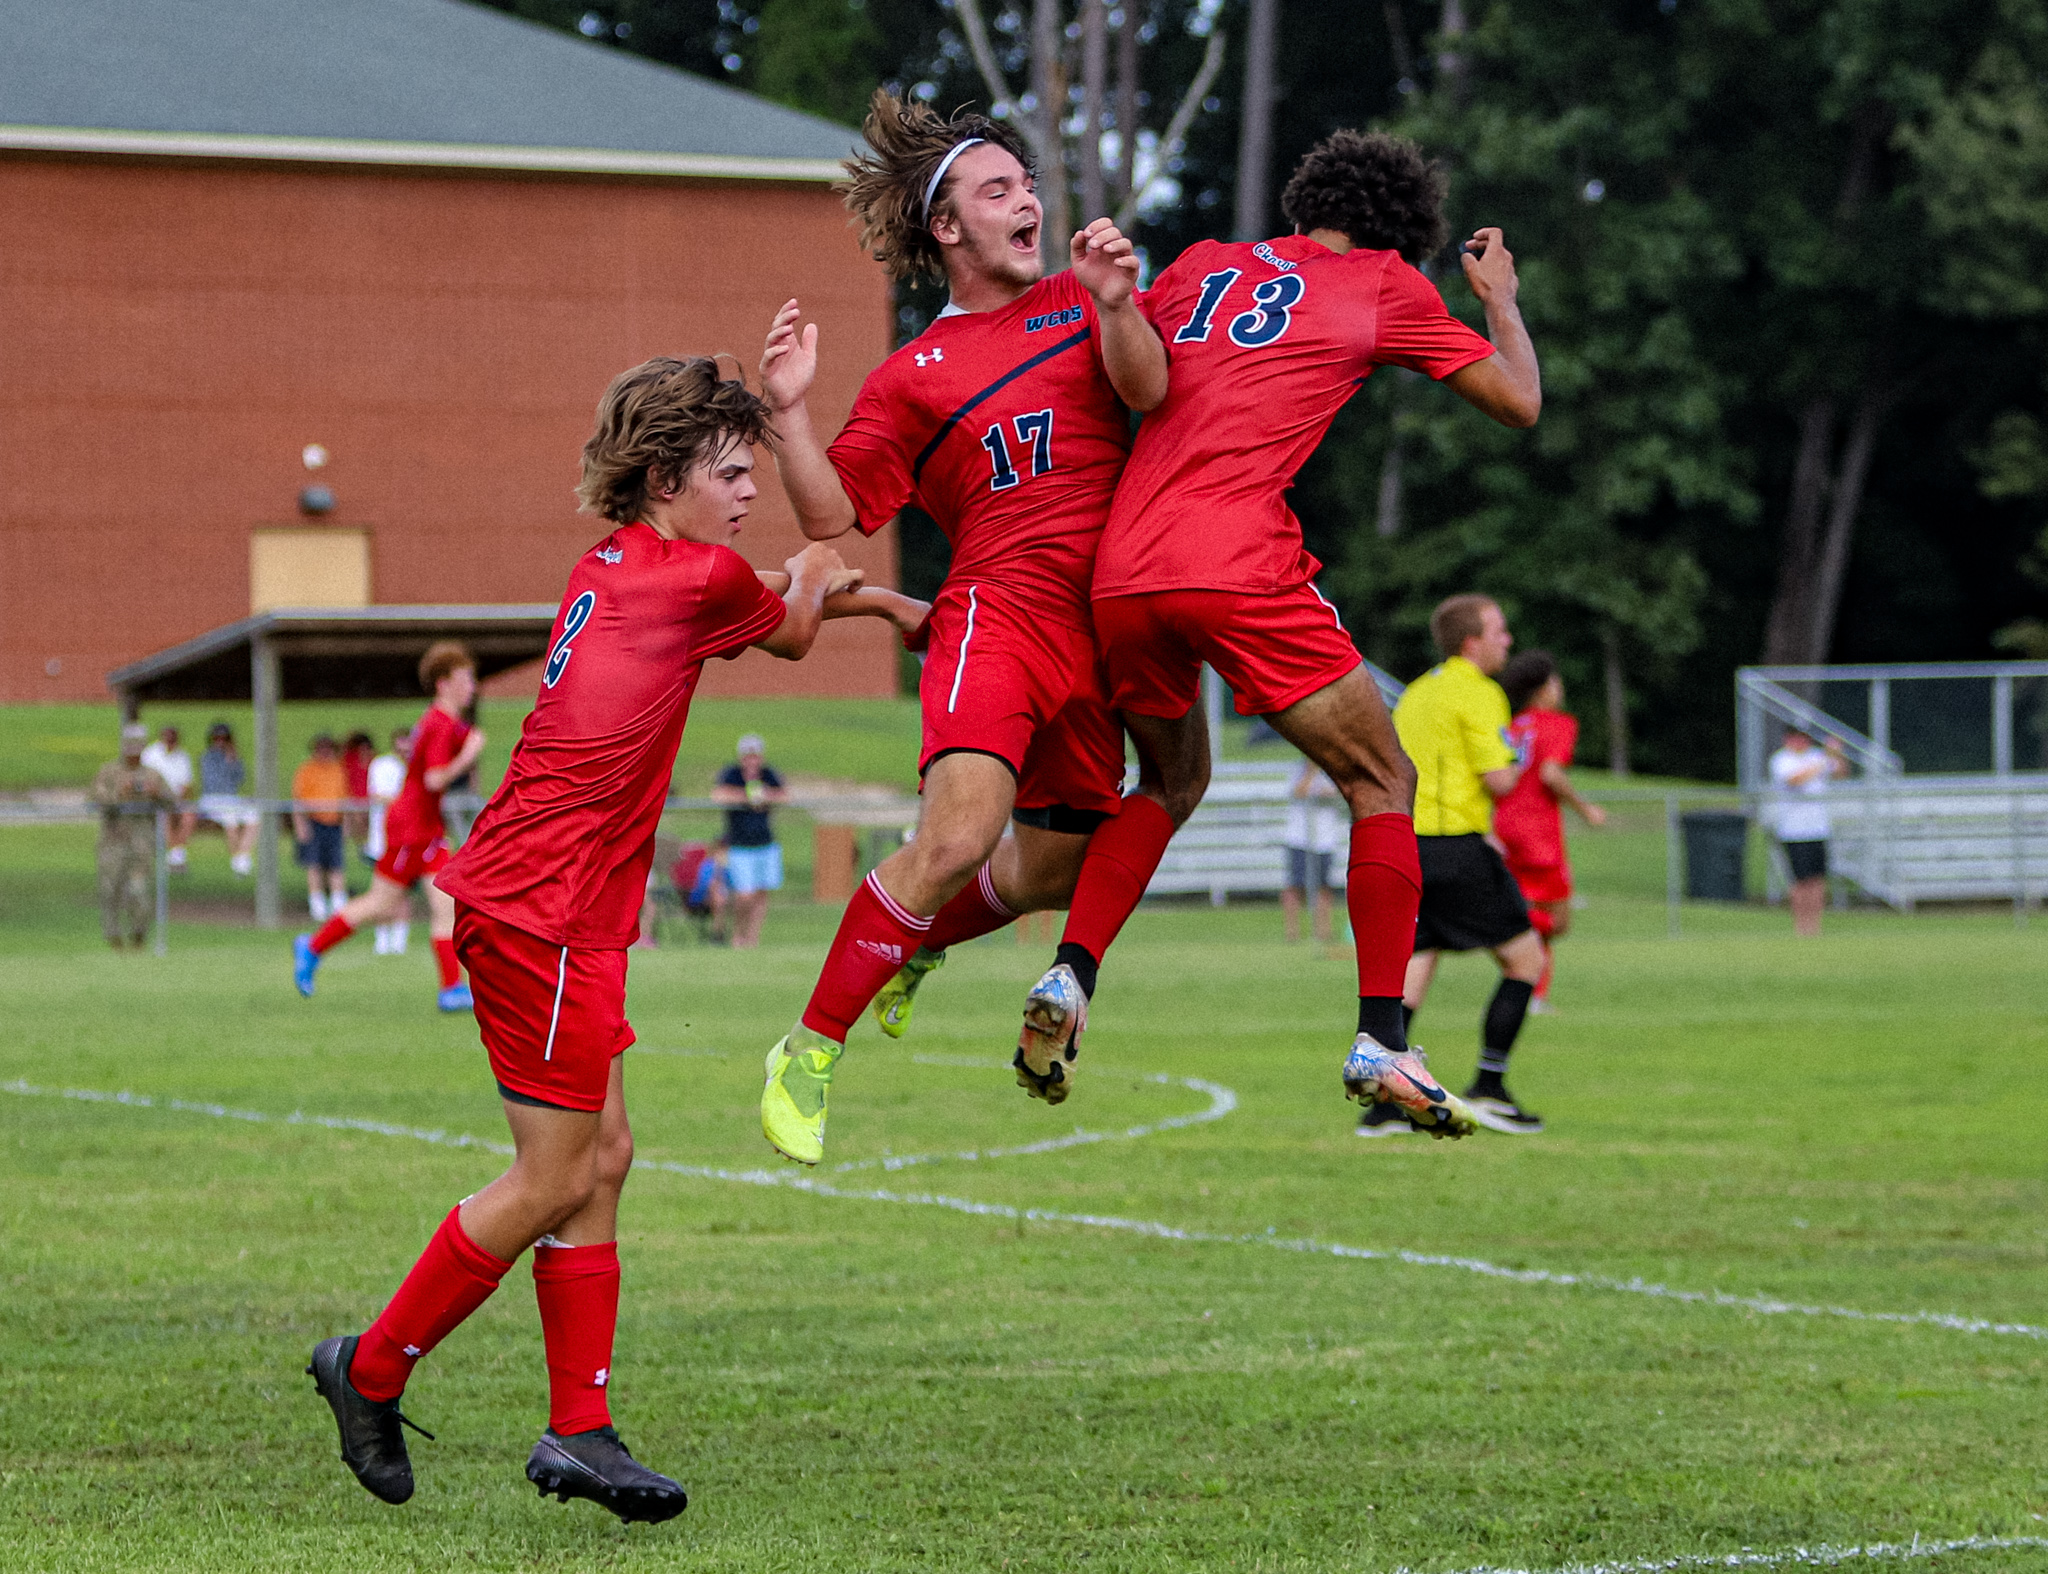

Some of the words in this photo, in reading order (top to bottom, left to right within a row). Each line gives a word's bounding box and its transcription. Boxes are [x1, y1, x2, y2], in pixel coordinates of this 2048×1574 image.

[1172, 267, 1306, 348] 13
[980, 408, 1053, 491] 17
[542, 590, 597, 689] 2
